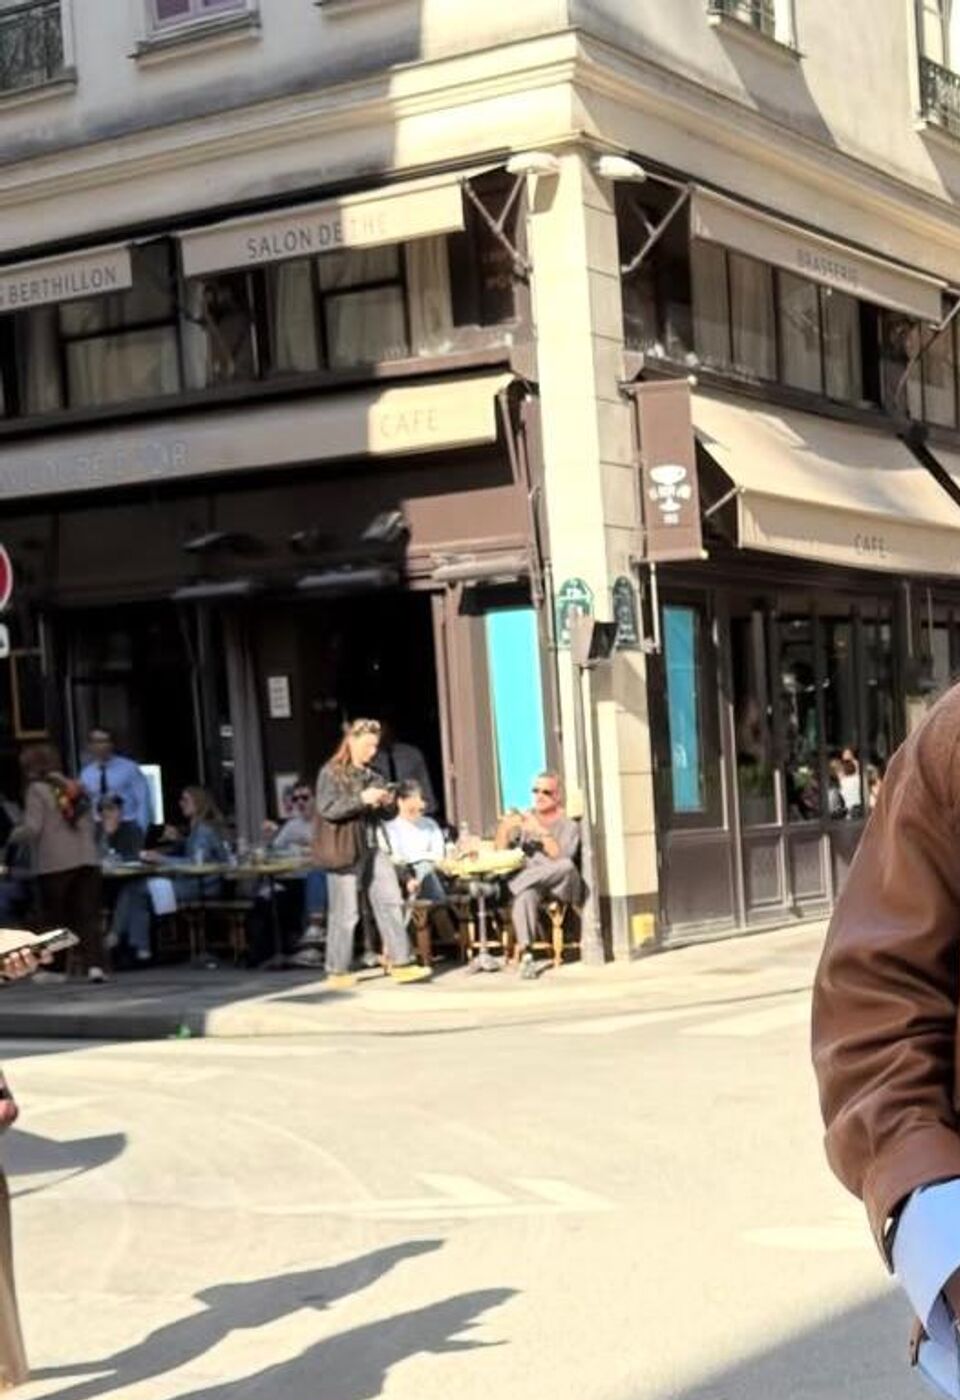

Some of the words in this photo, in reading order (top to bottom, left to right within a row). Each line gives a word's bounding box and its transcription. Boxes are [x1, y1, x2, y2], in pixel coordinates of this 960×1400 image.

[247, 226, 312, 259] SALON
[318, 221, 343, 246] DE
[8, 264, 117, 305] BERTHILLON
